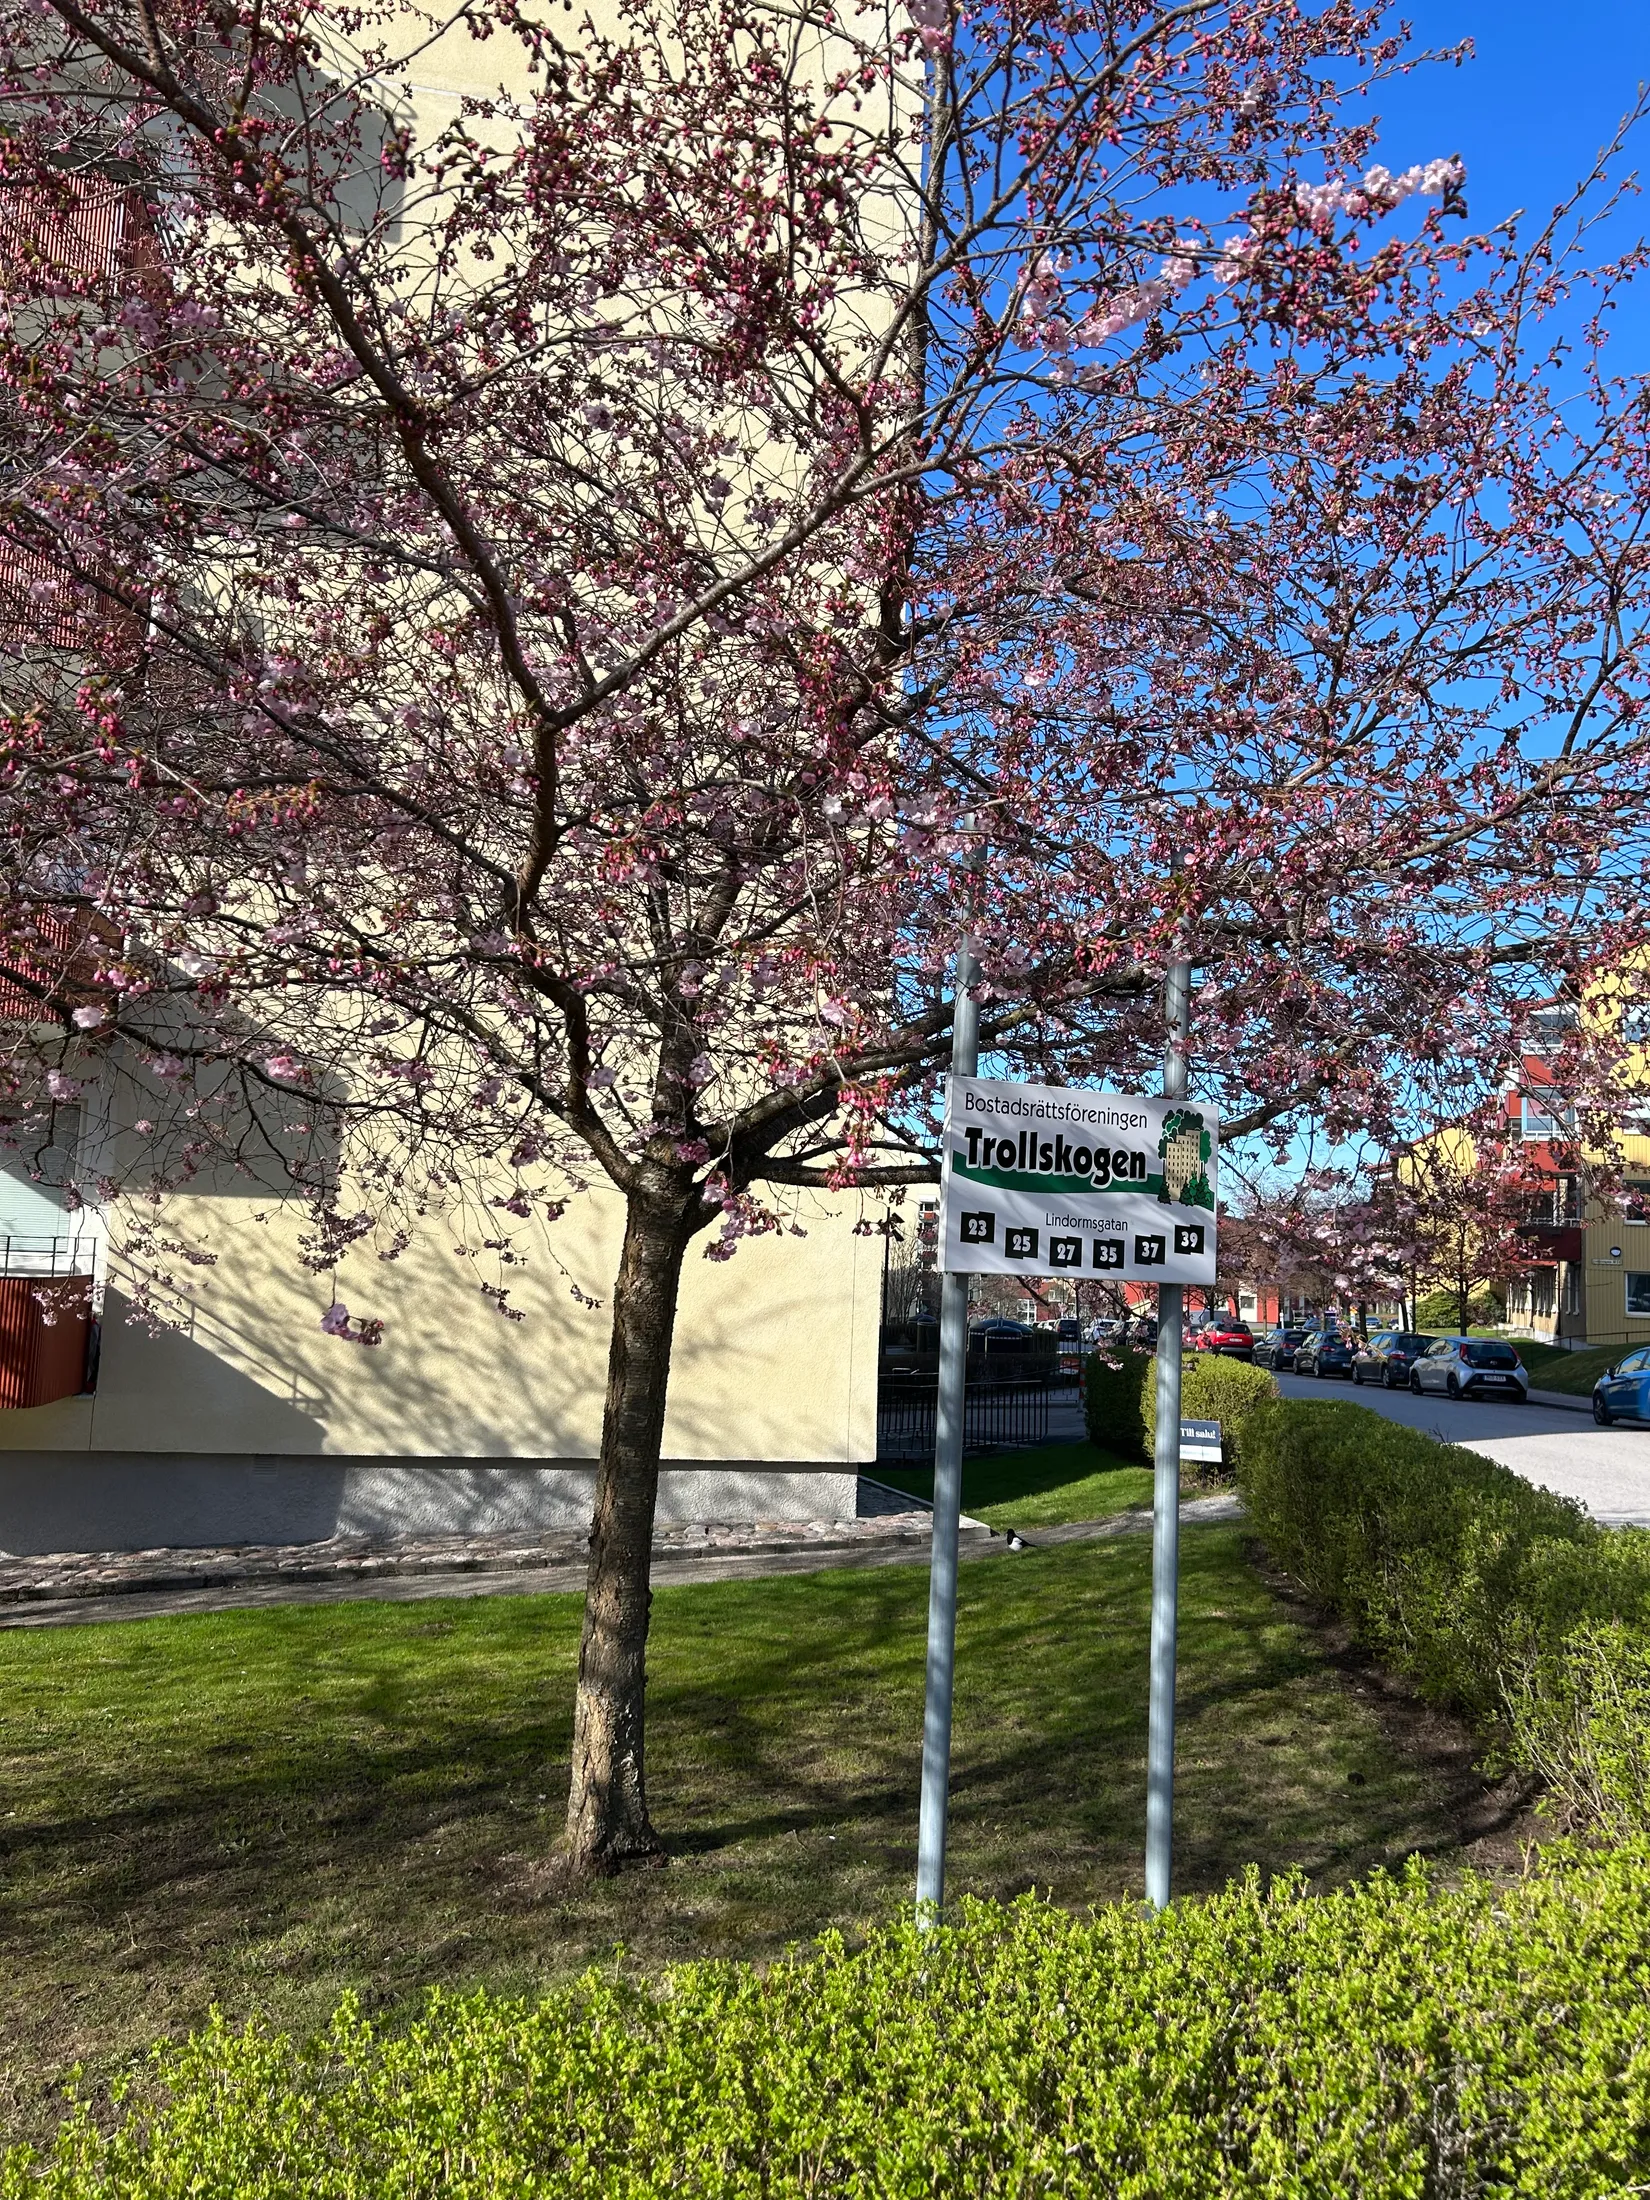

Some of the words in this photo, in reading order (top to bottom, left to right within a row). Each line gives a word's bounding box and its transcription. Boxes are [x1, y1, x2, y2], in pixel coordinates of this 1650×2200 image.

[965, 1092, 1148, 1130] Bostadsrättsföreningen
[964, 1127, 1147, 1186] Trollskogen
[968, 1218, 987, 1237] 23
[1012, 1234, 1031, 1252] 25
[1056, 1243, 1076, 1261] 27
[1099, 1245, 1117, 1263] 35
[1141, 1240, 1159, 1258] 37
[1180, 1231, 1199, 1248] 39
[1045, 1213, 1128, 1233] Lindormsgatan
[1180, 1427, 1195, 1437] Till
[1195, 1429, 1217, 1439] salu!
